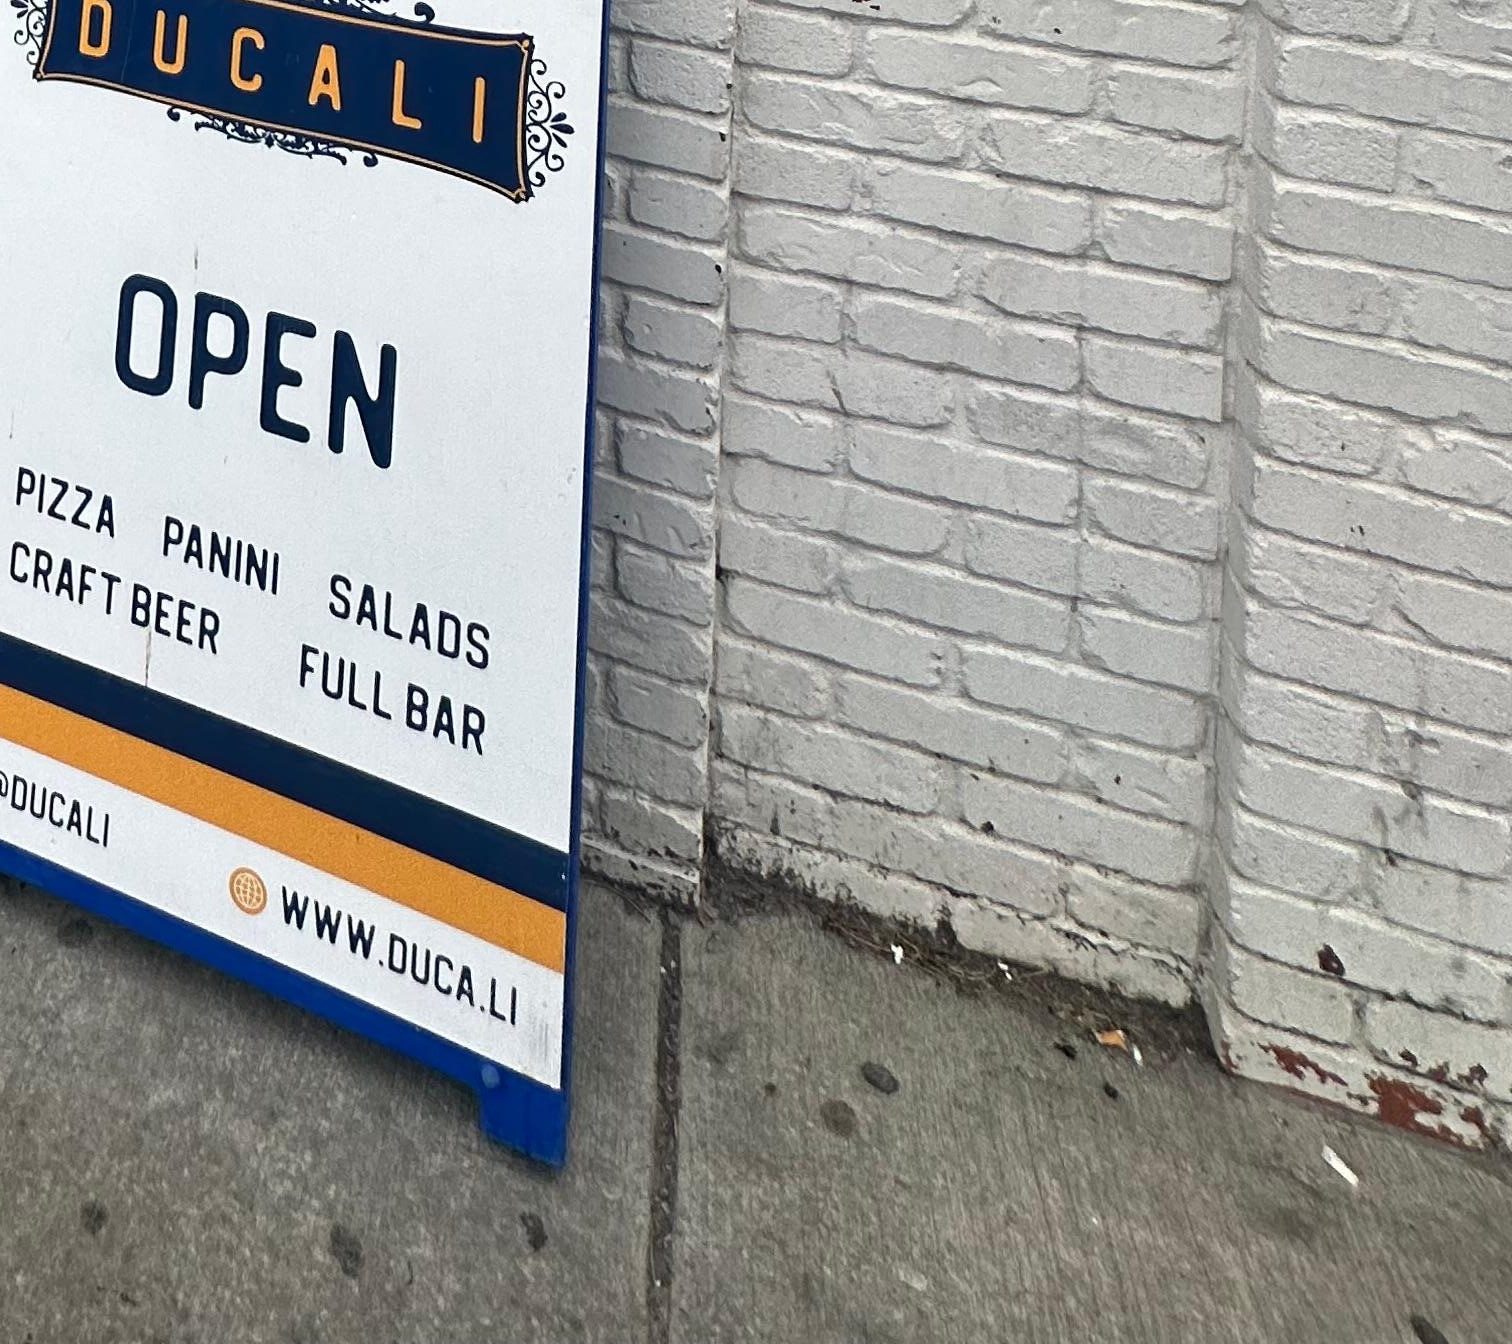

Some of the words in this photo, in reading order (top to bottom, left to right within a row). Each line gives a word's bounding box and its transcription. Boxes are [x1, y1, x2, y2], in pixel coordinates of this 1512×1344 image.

[114, 272, 398, 470] OPEN
[9, 541, 122, 615] CRAFT
[130, 583, 221, 655] BEER
[14, 466, 116, 539] PIZZA
[162, 515, 281, 596] PANINI
[328, 574, 491, 670] SALADS
[299, 643, 392, 721] FULL
[405, 682, 487, 756] BAR
[280, 884, 518, 1027] WWW.DUCA.LI
